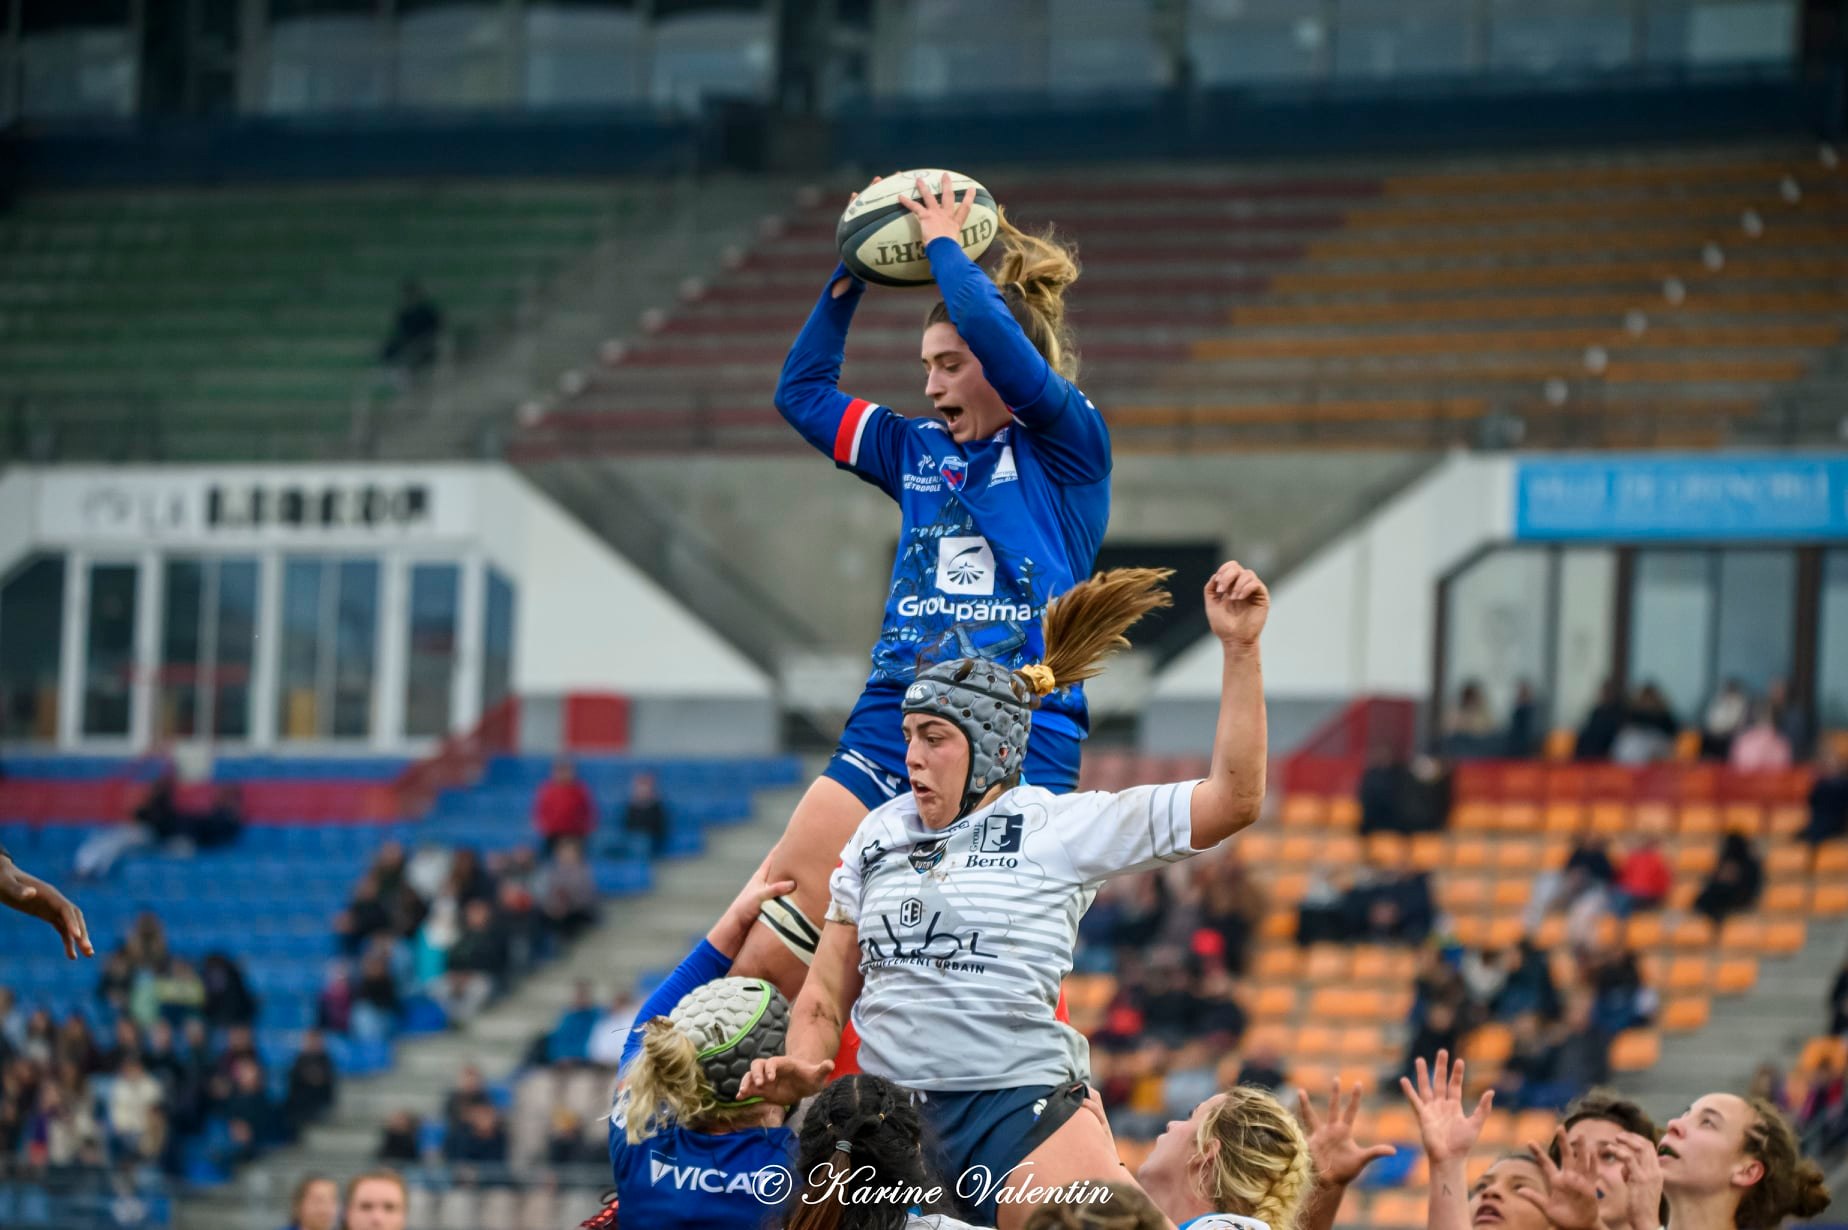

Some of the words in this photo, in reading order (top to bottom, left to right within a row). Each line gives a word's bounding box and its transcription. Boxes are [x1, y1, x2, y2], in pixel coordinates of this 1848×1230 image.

[875, 218, 993, 266] GILERT
[897, 595, 1032, 622] Groupama
[965, 855, 1019, 869] Berto
[935, 959, 985, 974] URBAIN
